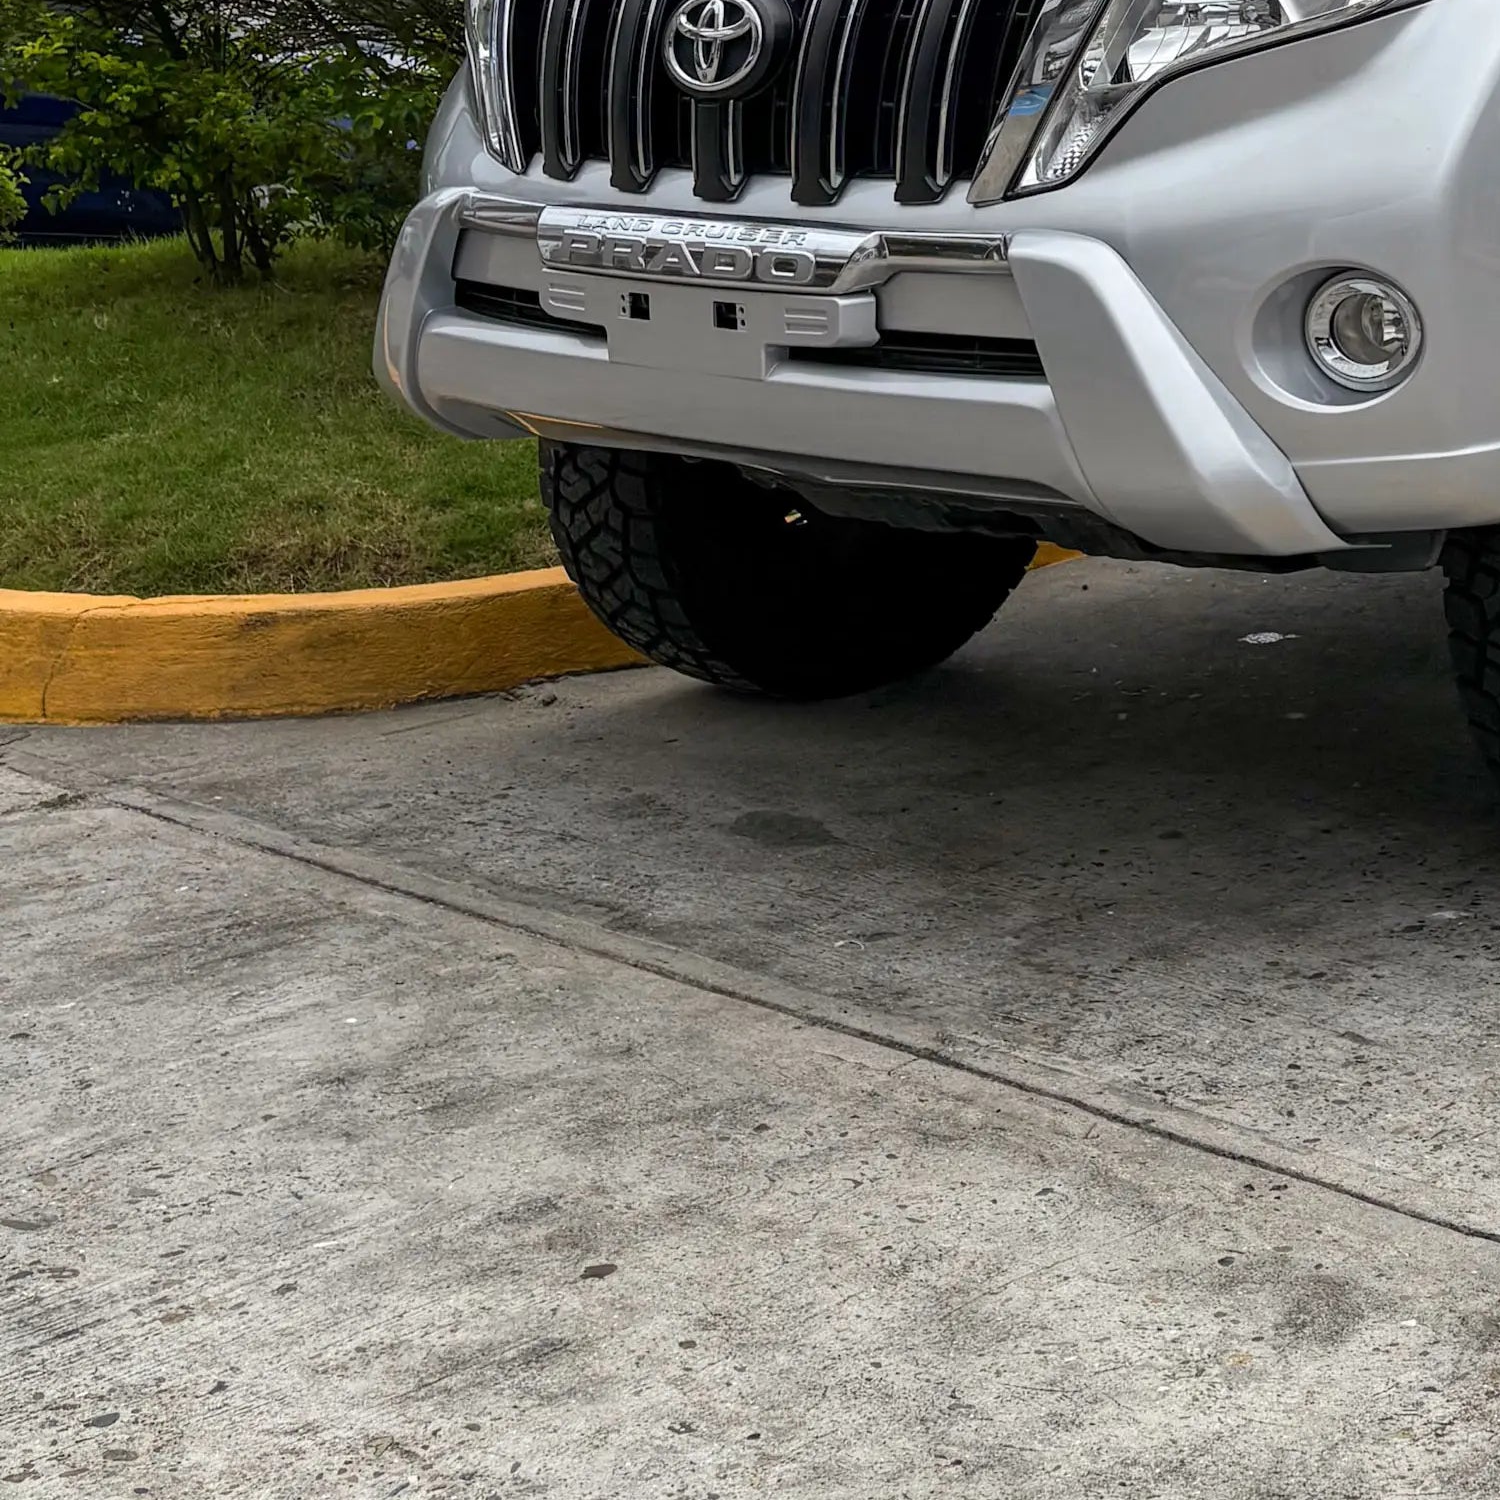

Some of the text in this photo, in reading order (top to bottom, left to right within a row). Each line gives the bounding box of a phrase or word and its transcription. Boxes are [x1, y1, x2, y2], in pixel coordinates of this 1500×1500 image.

[577, 215, 808, 246] LAND CRUISER
[561, 229, 816, 283] PRADO
